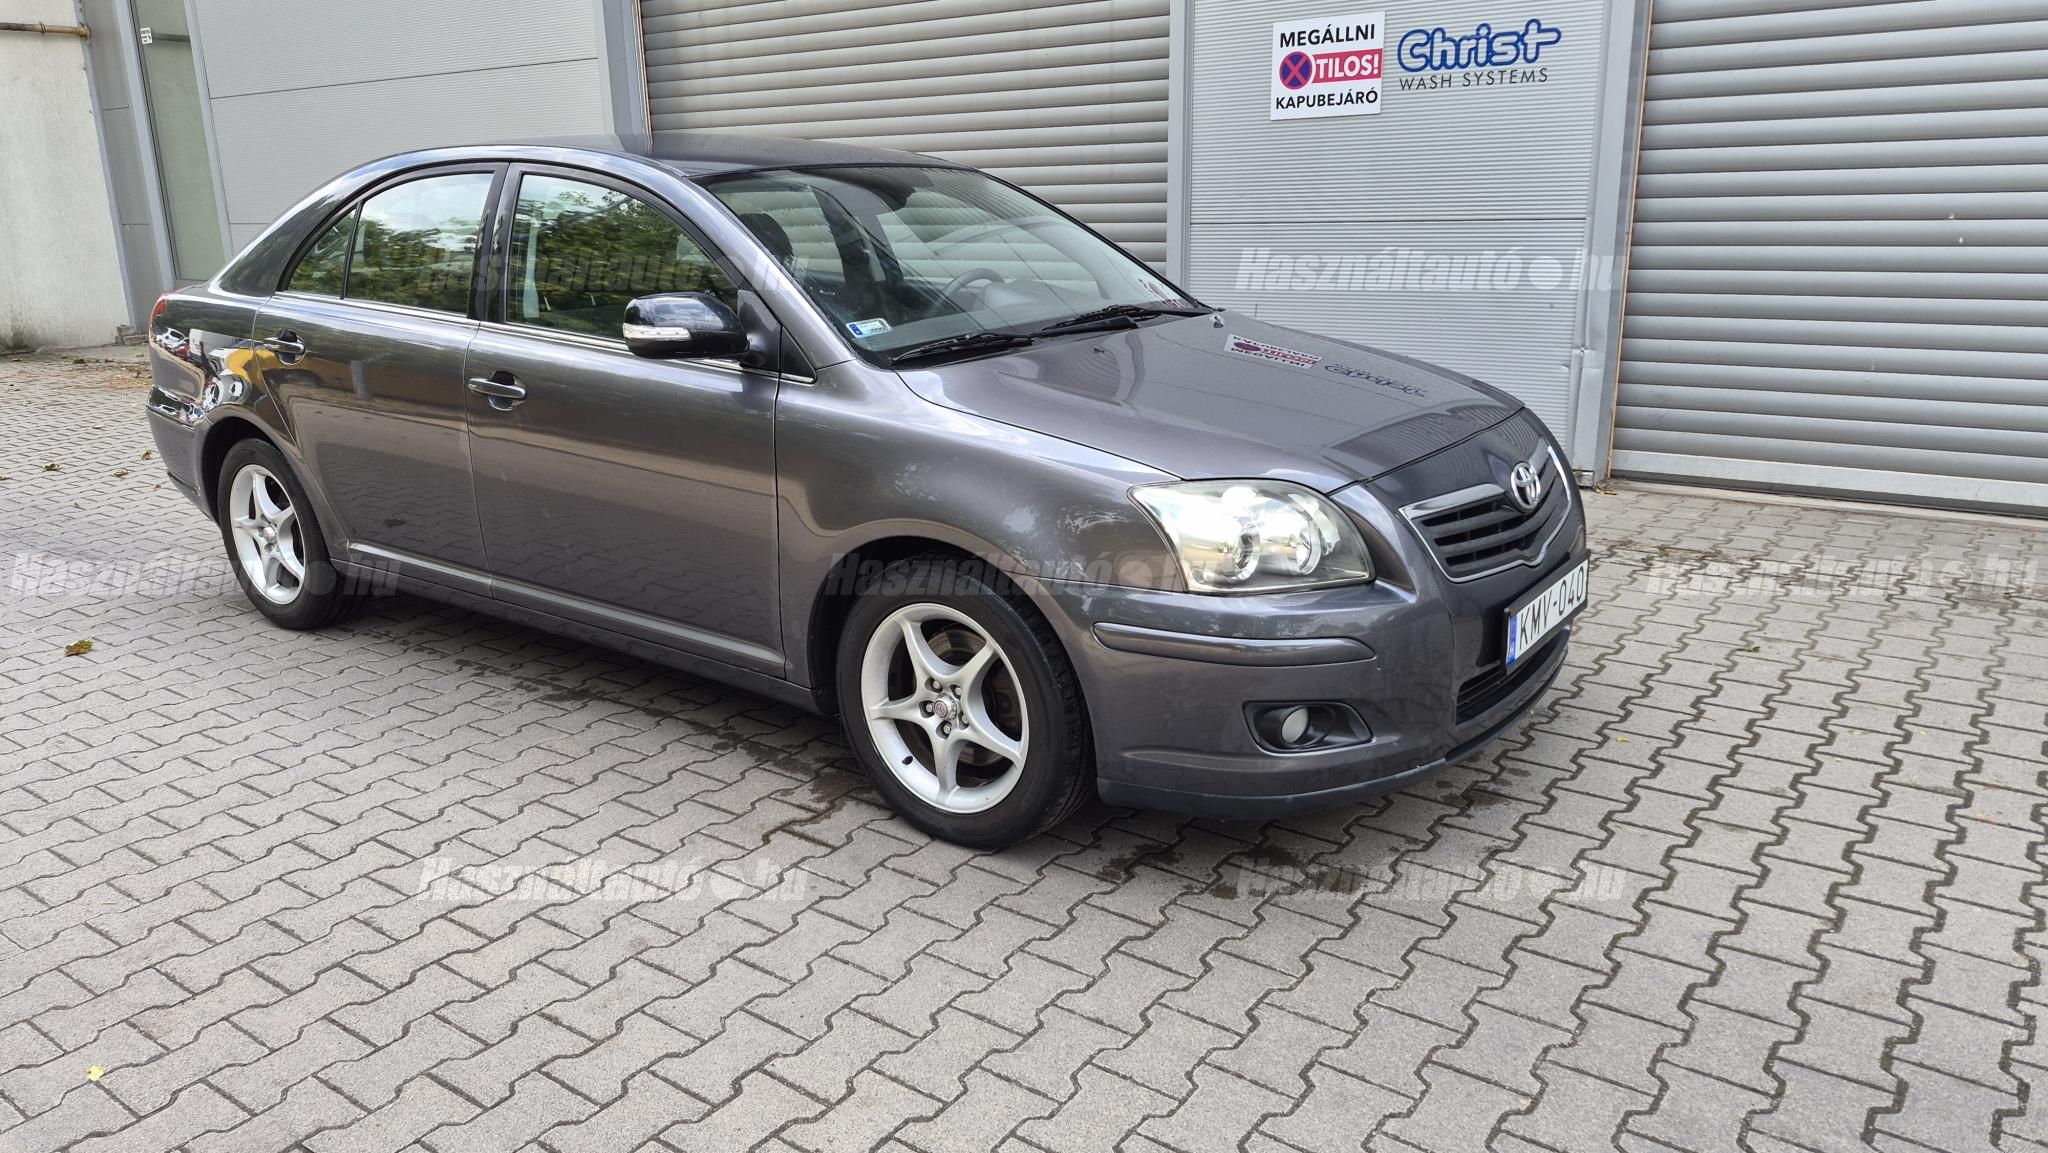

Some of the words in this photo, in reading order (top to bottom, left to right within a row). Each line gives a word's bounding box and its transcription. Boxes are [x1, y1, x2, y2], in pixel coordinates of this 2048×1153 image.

[1279, 23, 1376, 48] MEGÁLLNI
[1397, 18, 1562, 73] Christ
[1315, 54, 1380, 80] TILOS!
[1400, 74, 1452, 91] WASH
[1462, 67, 1549, 88] SYSTEMS
[1275, 88, 1379, 110] KAPUBEJÁRÓ
[1518, 566, 1585, 650] KMV-040
